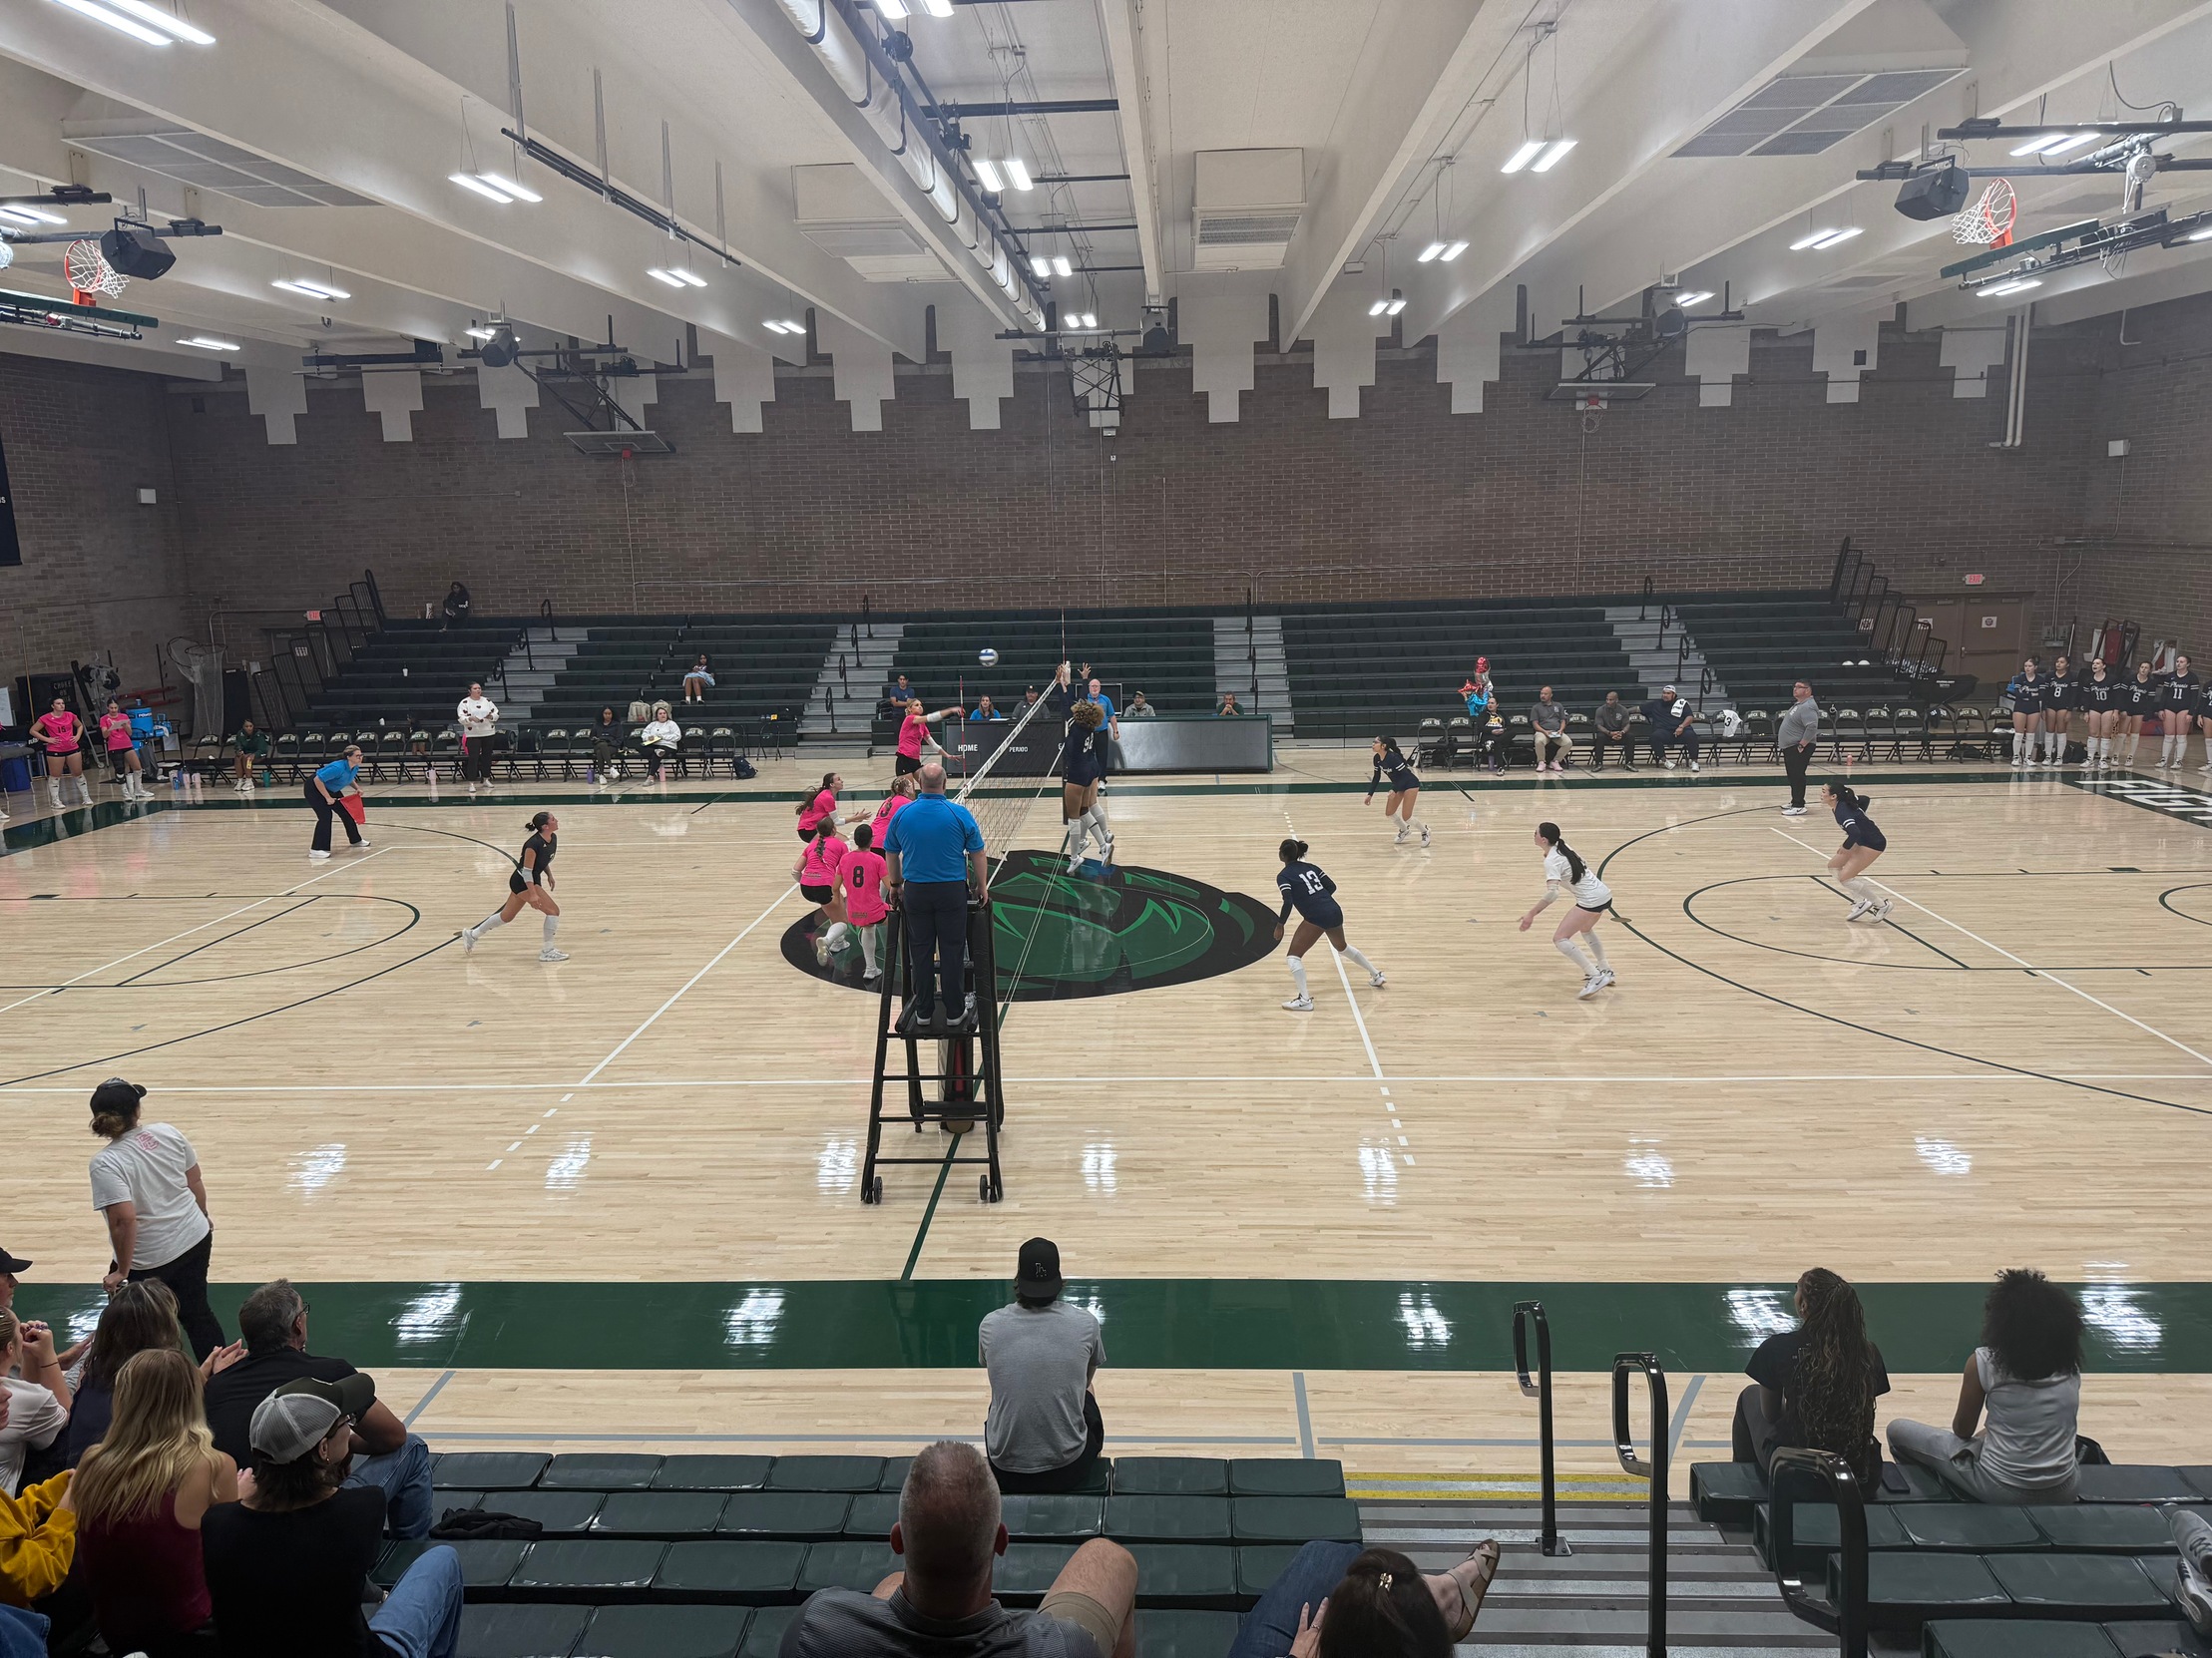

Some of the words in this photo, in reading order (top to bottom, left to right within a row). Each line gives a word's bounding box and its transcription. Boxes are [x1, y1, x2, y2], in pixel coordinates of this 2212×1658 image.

[2053, 687, 2062, 697] 8
[2095, 690, 2107, 701] 10
[2132, 692, 2141, 703] 6
[2172, 687, 2183, 699] 11
[1724, 716, 1732, 727] 3
[852, 865, 865, 888] 8
[1298, 870, 1324, 895] 13
